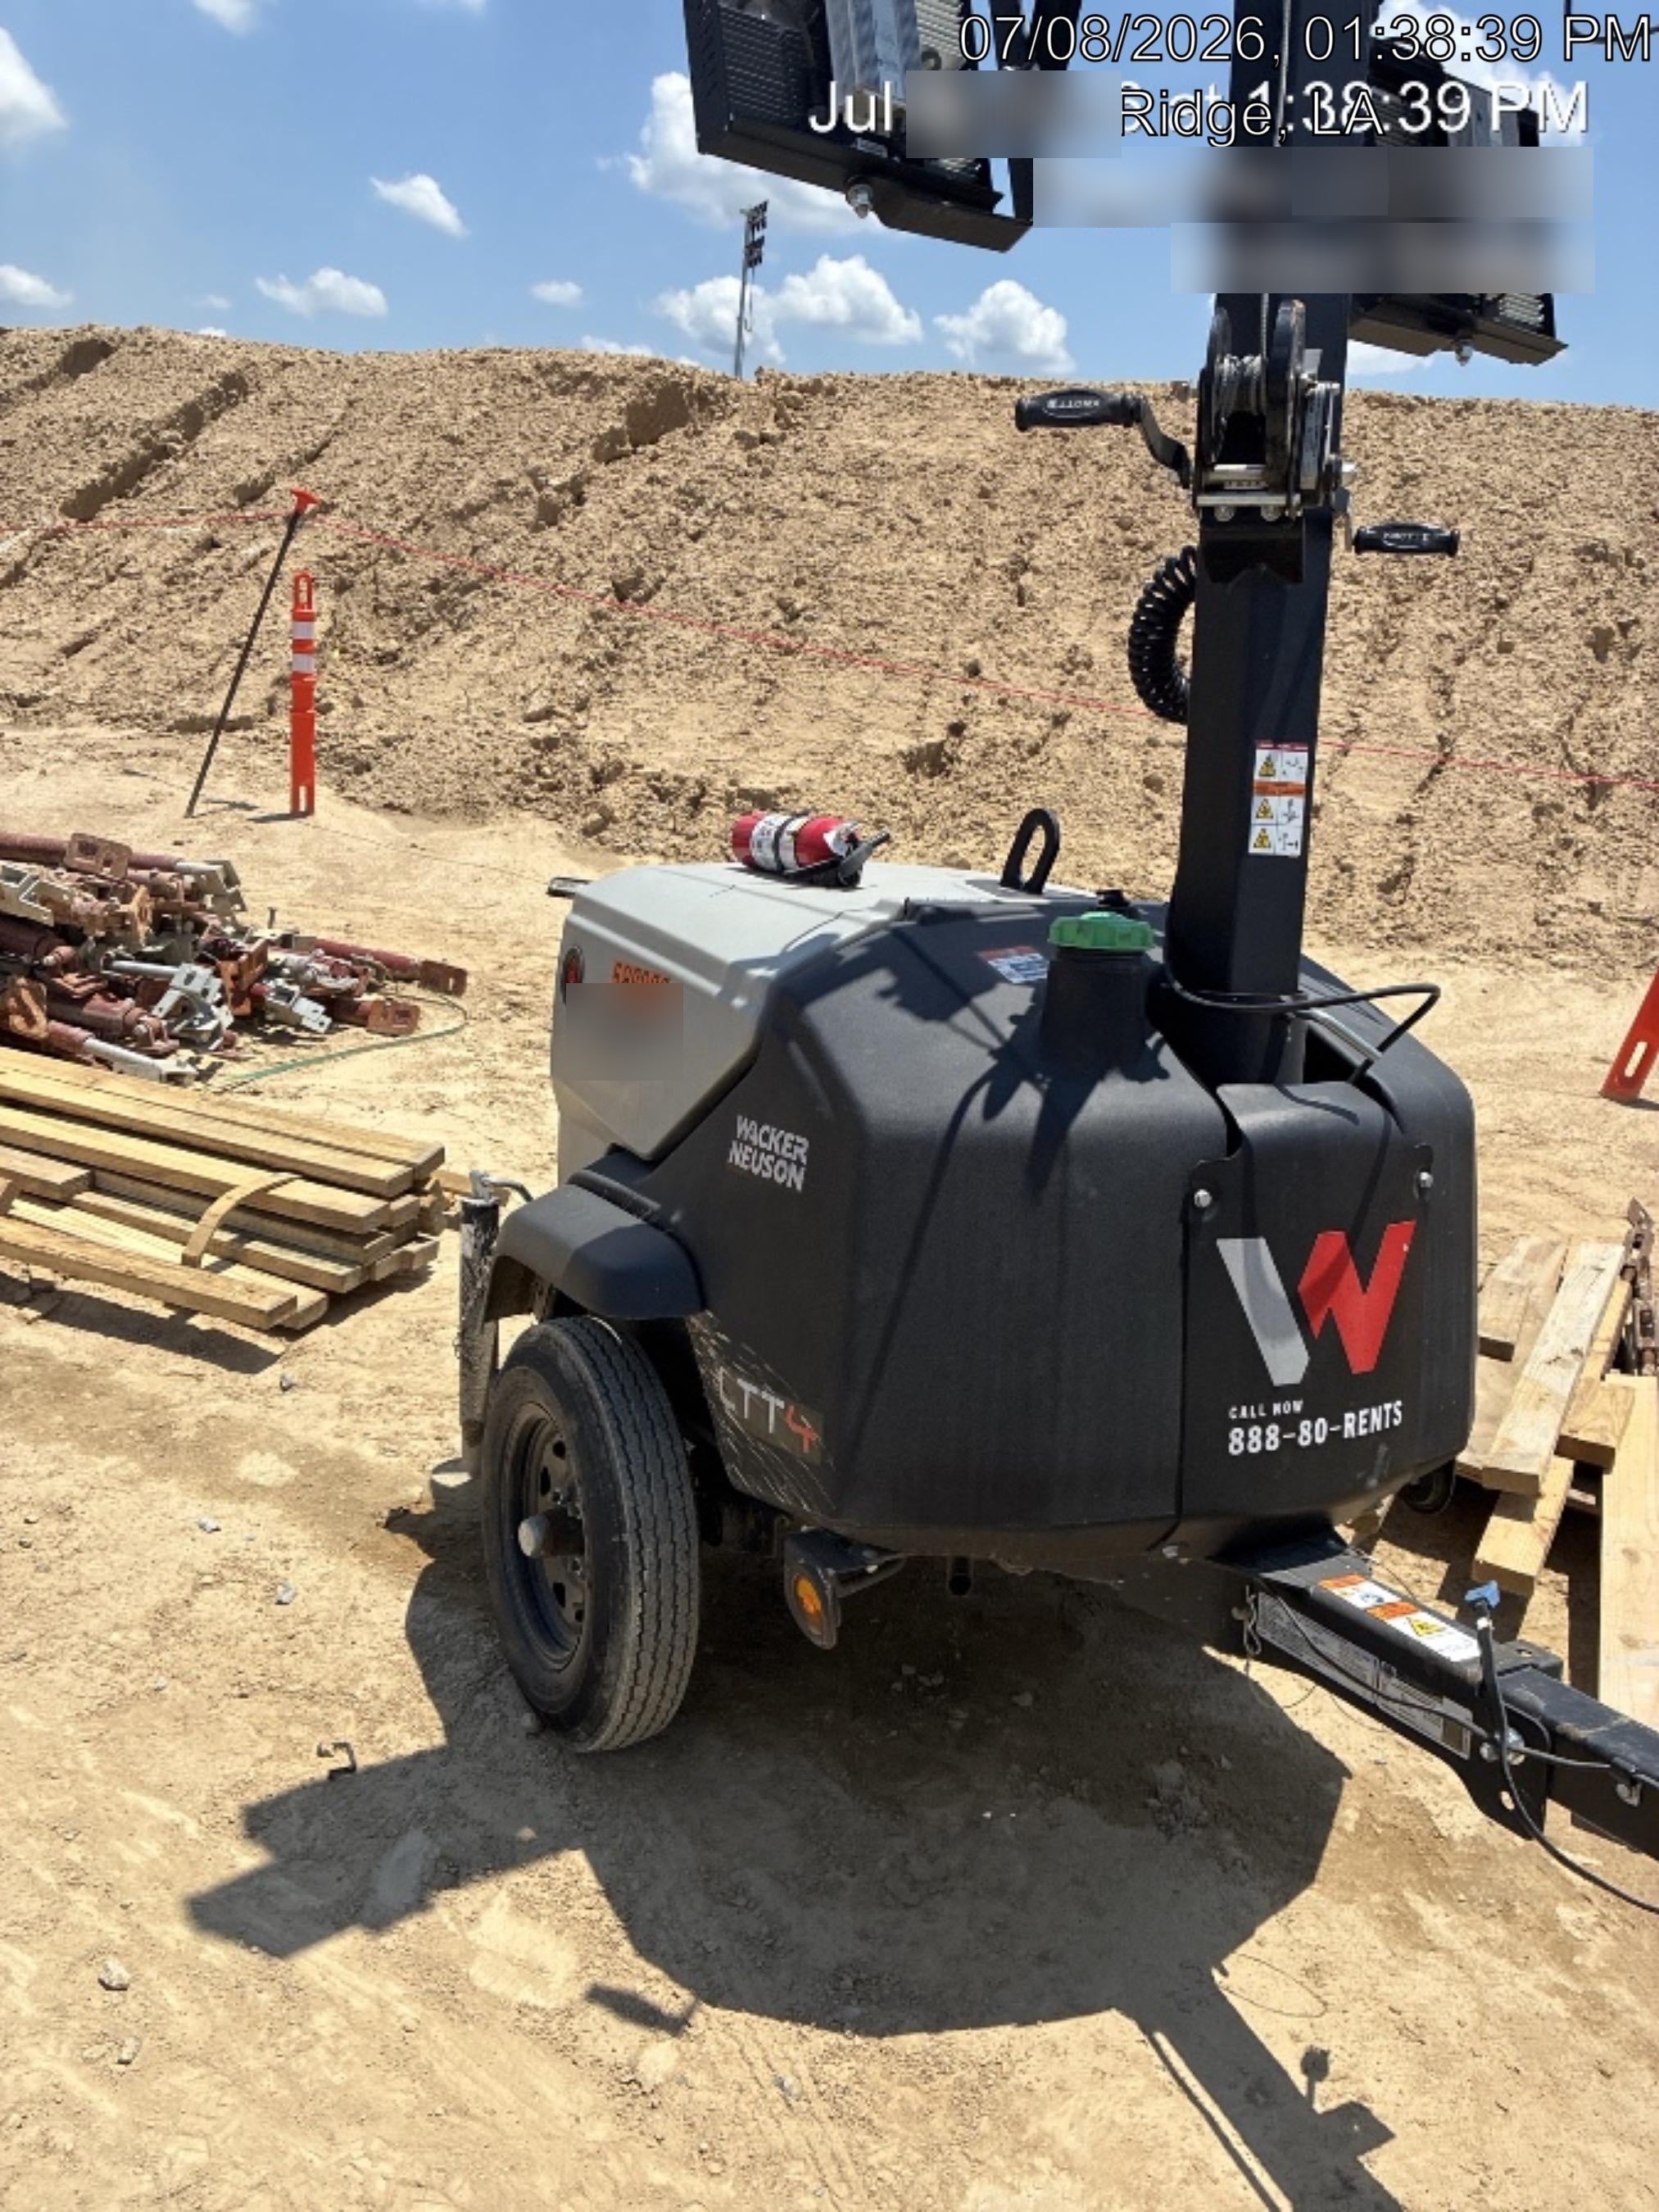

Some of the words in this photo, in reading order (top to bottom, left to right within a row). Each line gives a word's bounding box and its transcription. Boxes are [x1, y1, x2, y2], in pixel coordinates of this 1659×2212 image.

[728, 1140, 806, 1192] NEUSON
[737, 1115, 809, 1166] WACKER
[1228, 1399, 1403, 1456] 888-80-RENTS
[1229, 1403, 1267, 1420] CALL
[1272, 1398, 1303, 1416] NOW
